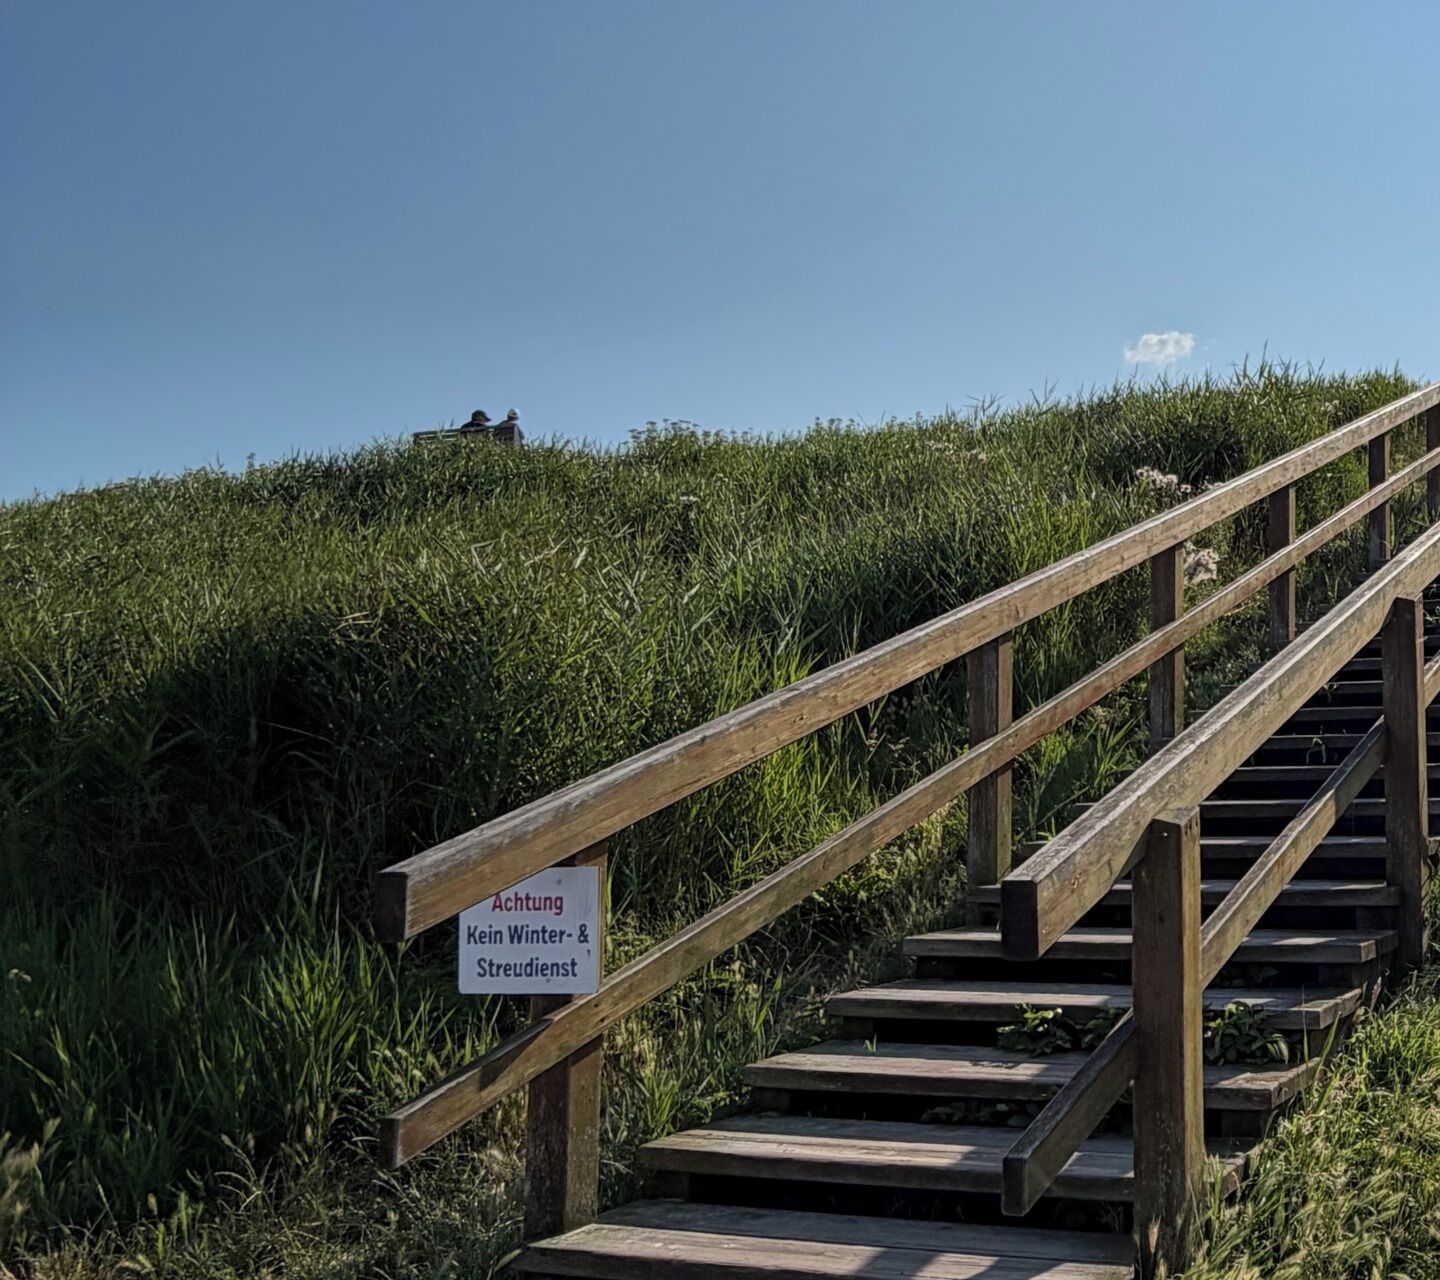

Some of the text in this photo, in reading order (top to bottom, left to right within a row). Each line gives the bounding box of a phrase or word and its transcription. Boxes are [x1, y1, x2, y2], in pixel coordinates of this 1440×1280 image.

[492, 892, 564, 916] Achtung
[467, 923, 589, 945] Kein Winter- &
[477, 957, 578, 978] Streudienst
